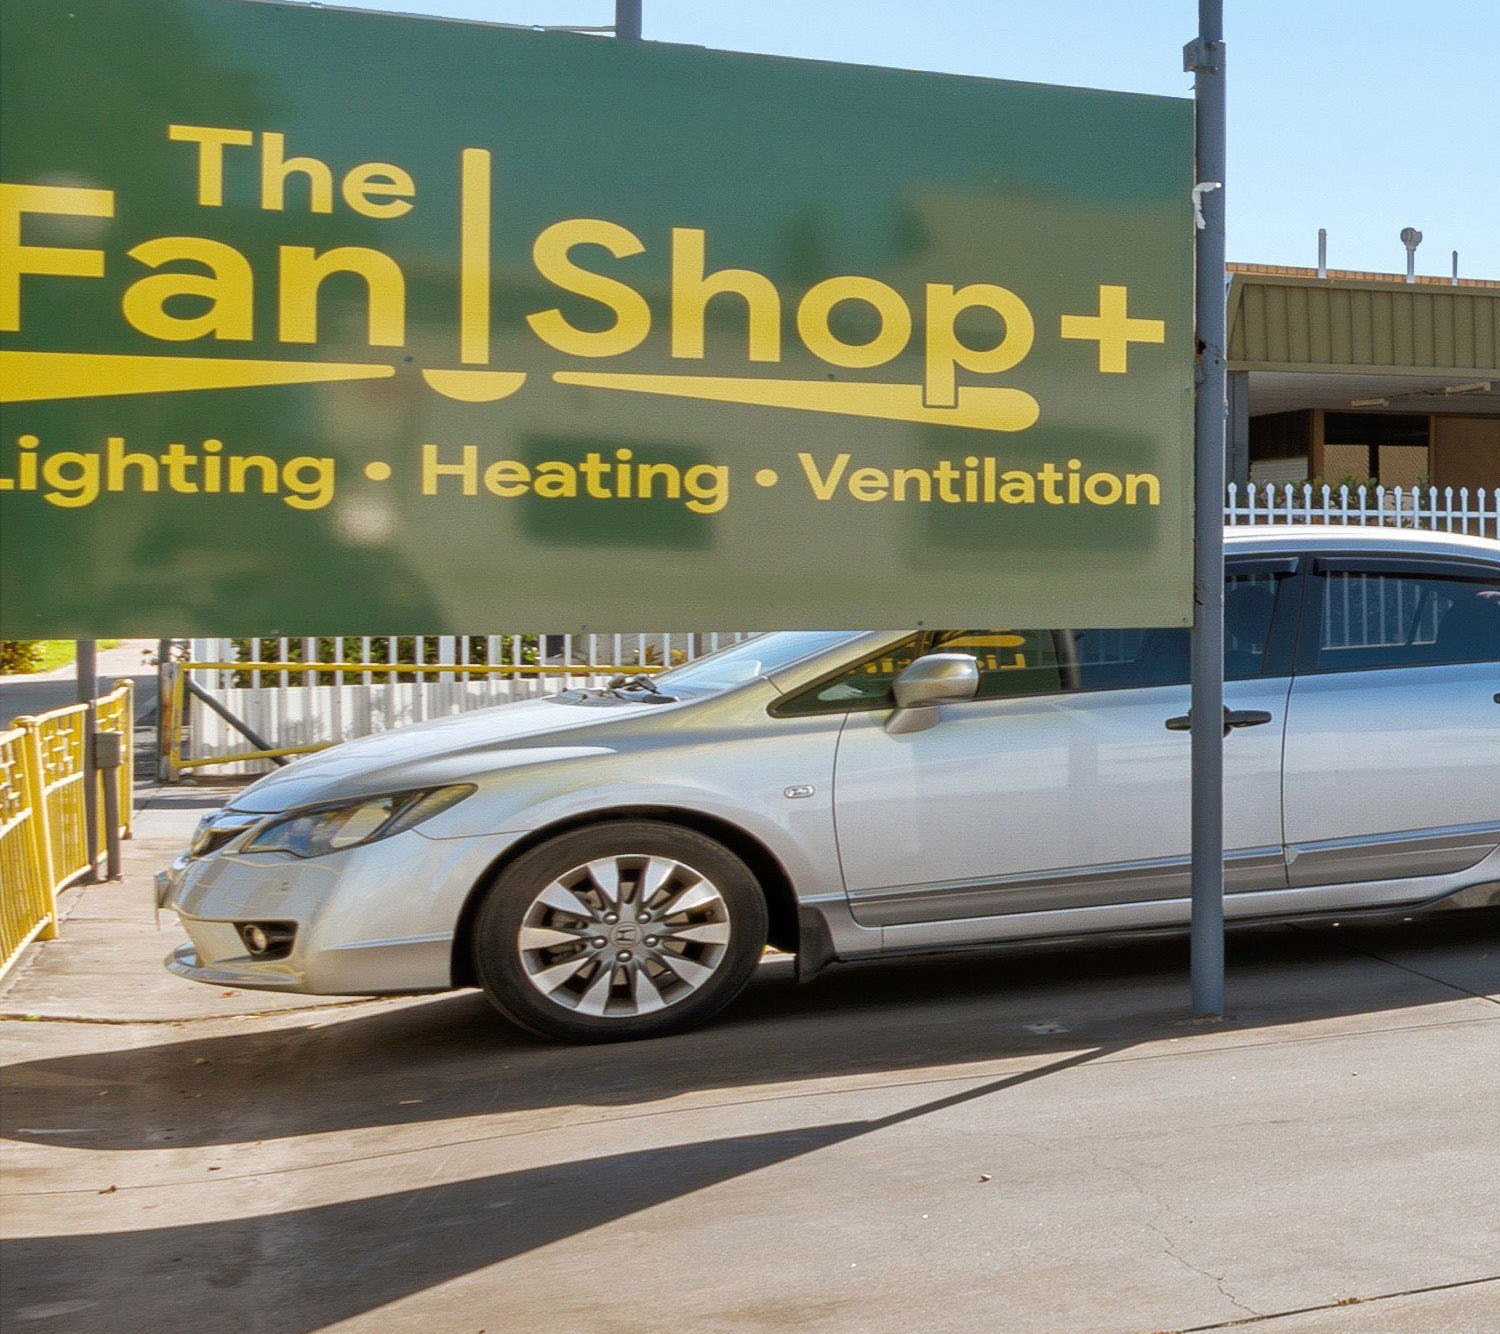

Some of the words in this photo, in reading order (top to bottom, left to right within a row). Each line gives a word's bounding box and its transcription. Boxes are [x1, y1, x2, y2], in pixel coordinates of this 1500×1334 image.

[167, 124, 416, 219] The
[0, 183, 405, 347] Fan
[422, 444, 729, 514] Heating
[798, 453, 1160, 506] Ventilation
